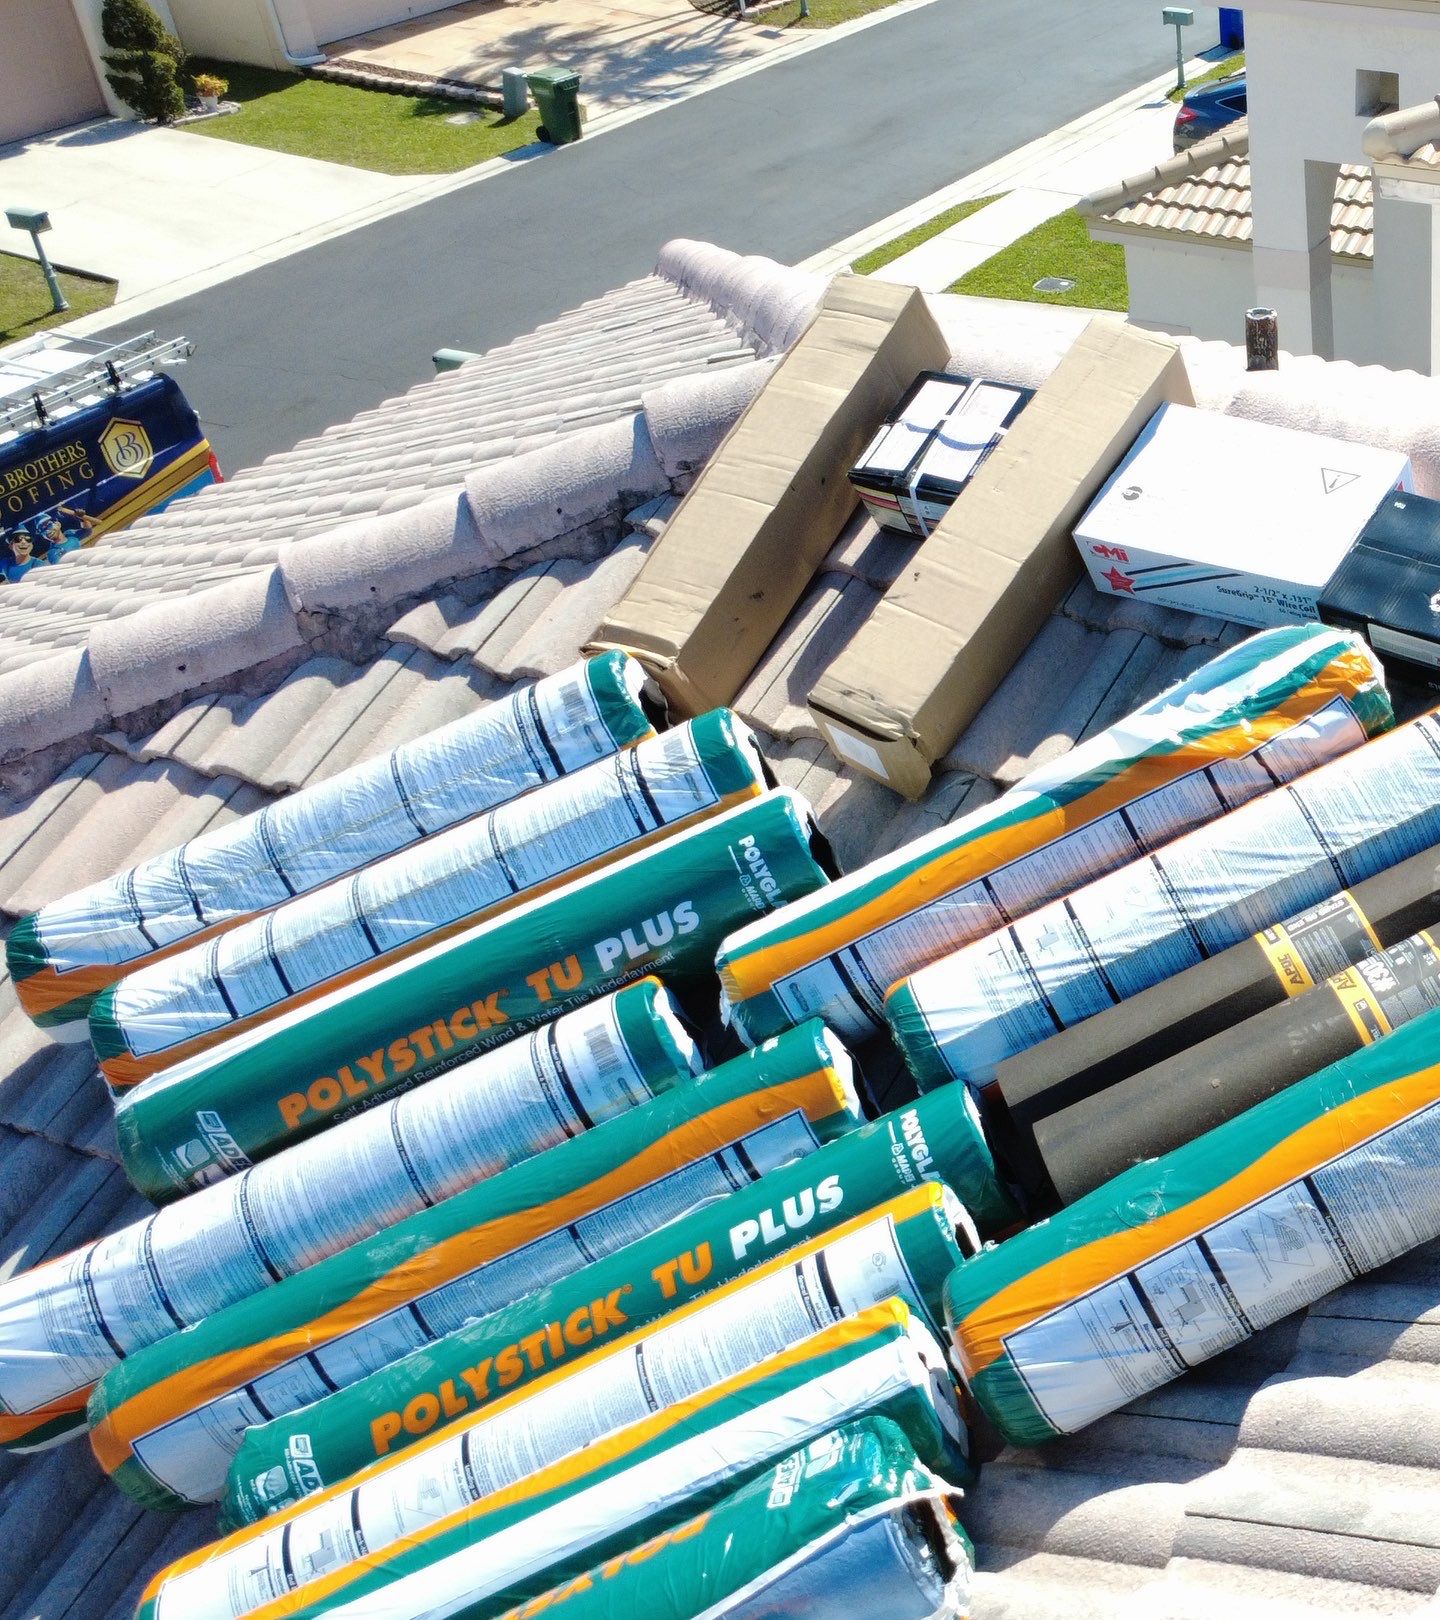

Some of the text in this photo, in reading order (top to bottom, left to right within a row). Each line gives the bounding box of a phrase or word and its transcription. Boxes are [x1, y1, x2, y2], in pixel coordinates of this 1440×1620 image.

[4, 440, 86, 489] BROTHERS
[525, 954, 585, 1002] TU
[593, 900, 701, 973] PLUS
[333, 1075, 414, 1123] Self-Adhered
[414, 1046, 481, 1082] Reinforced
[482, 1027, 514, 1052] Wind
[526, 1003, 565, 1030] Water
[564, 988, 592, 1010] Tile
[591, 949, 677, 997] Underlayment
[652, 1240, 714, 1300] TU
[729, 1174, 844, 1261] PLUS
